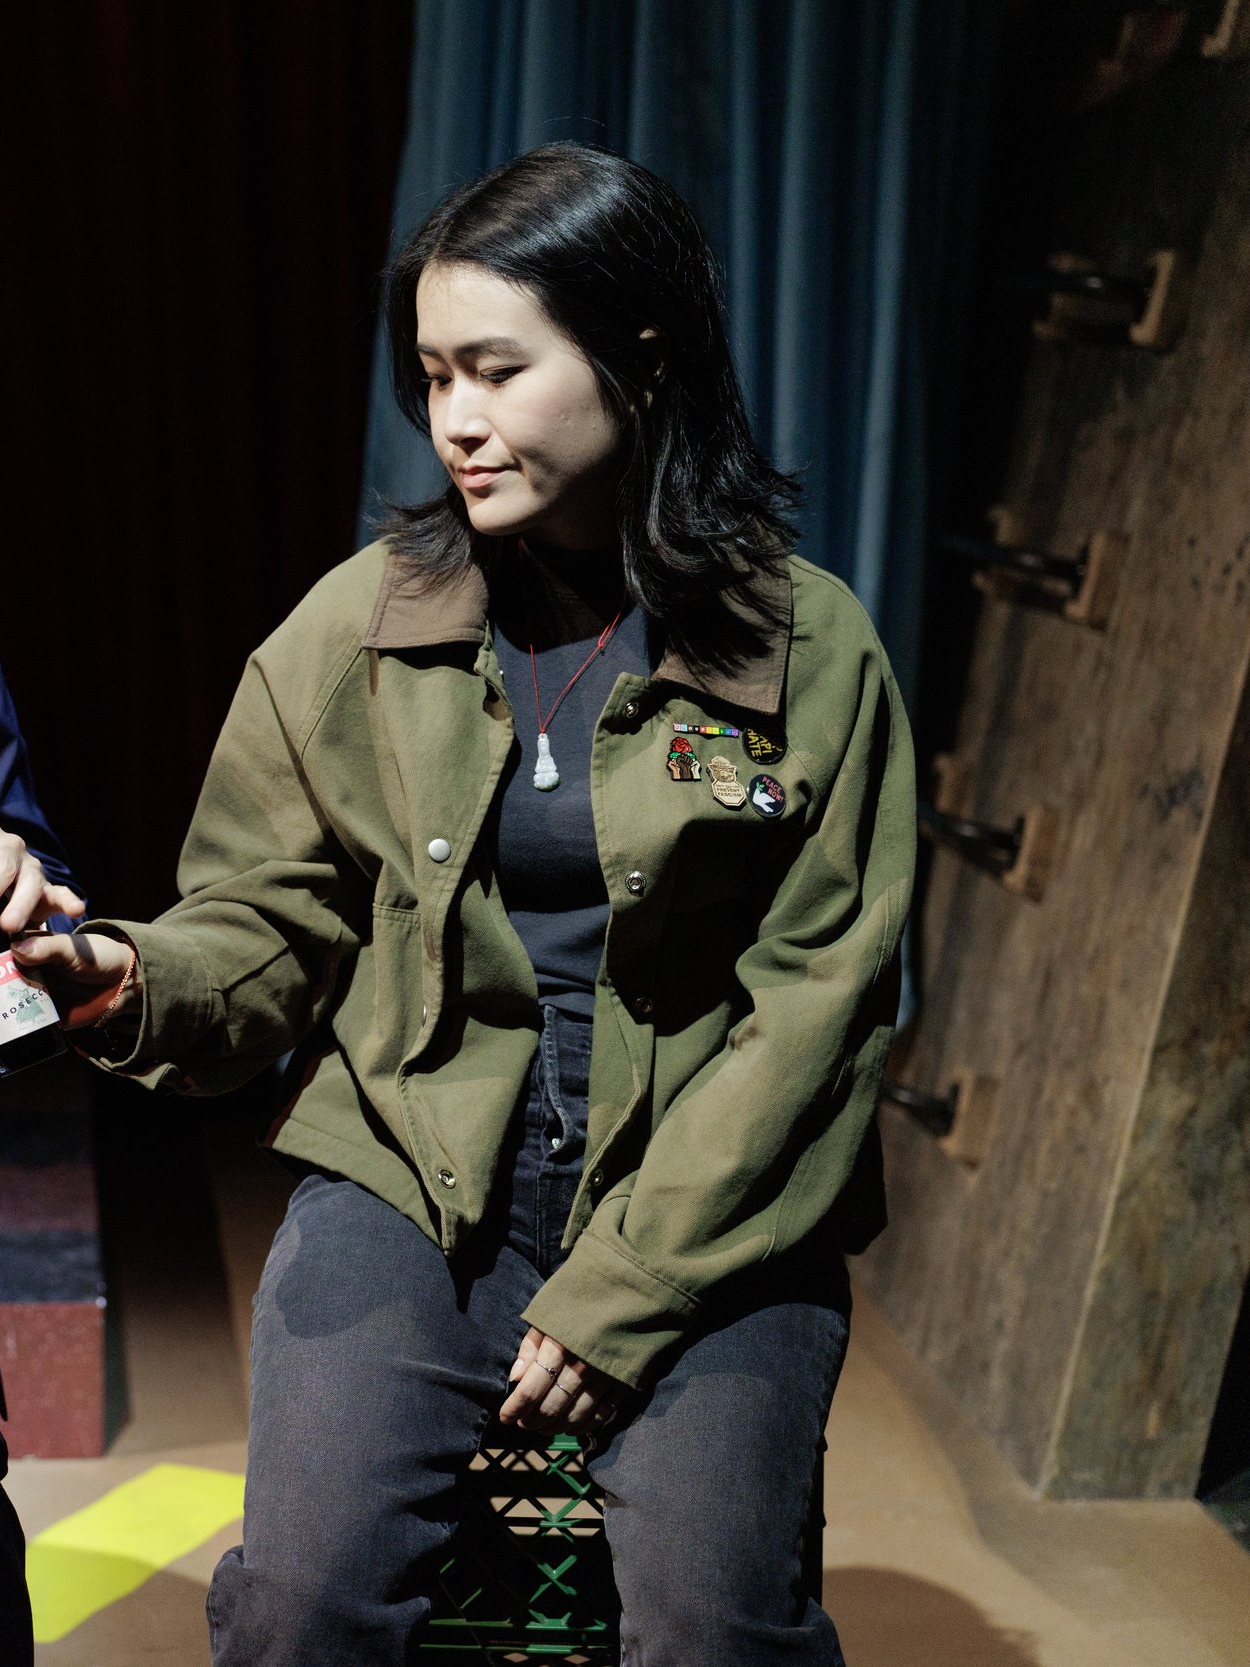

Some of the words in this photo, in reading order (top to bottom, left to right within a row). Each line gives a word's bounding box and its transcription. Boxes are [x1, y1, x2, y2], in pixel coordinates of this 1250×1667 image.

[747, 728, 763, 758] HATE
[762, 776, 783, 794] PEACE
[767, 788, 784, 803] NOW!
